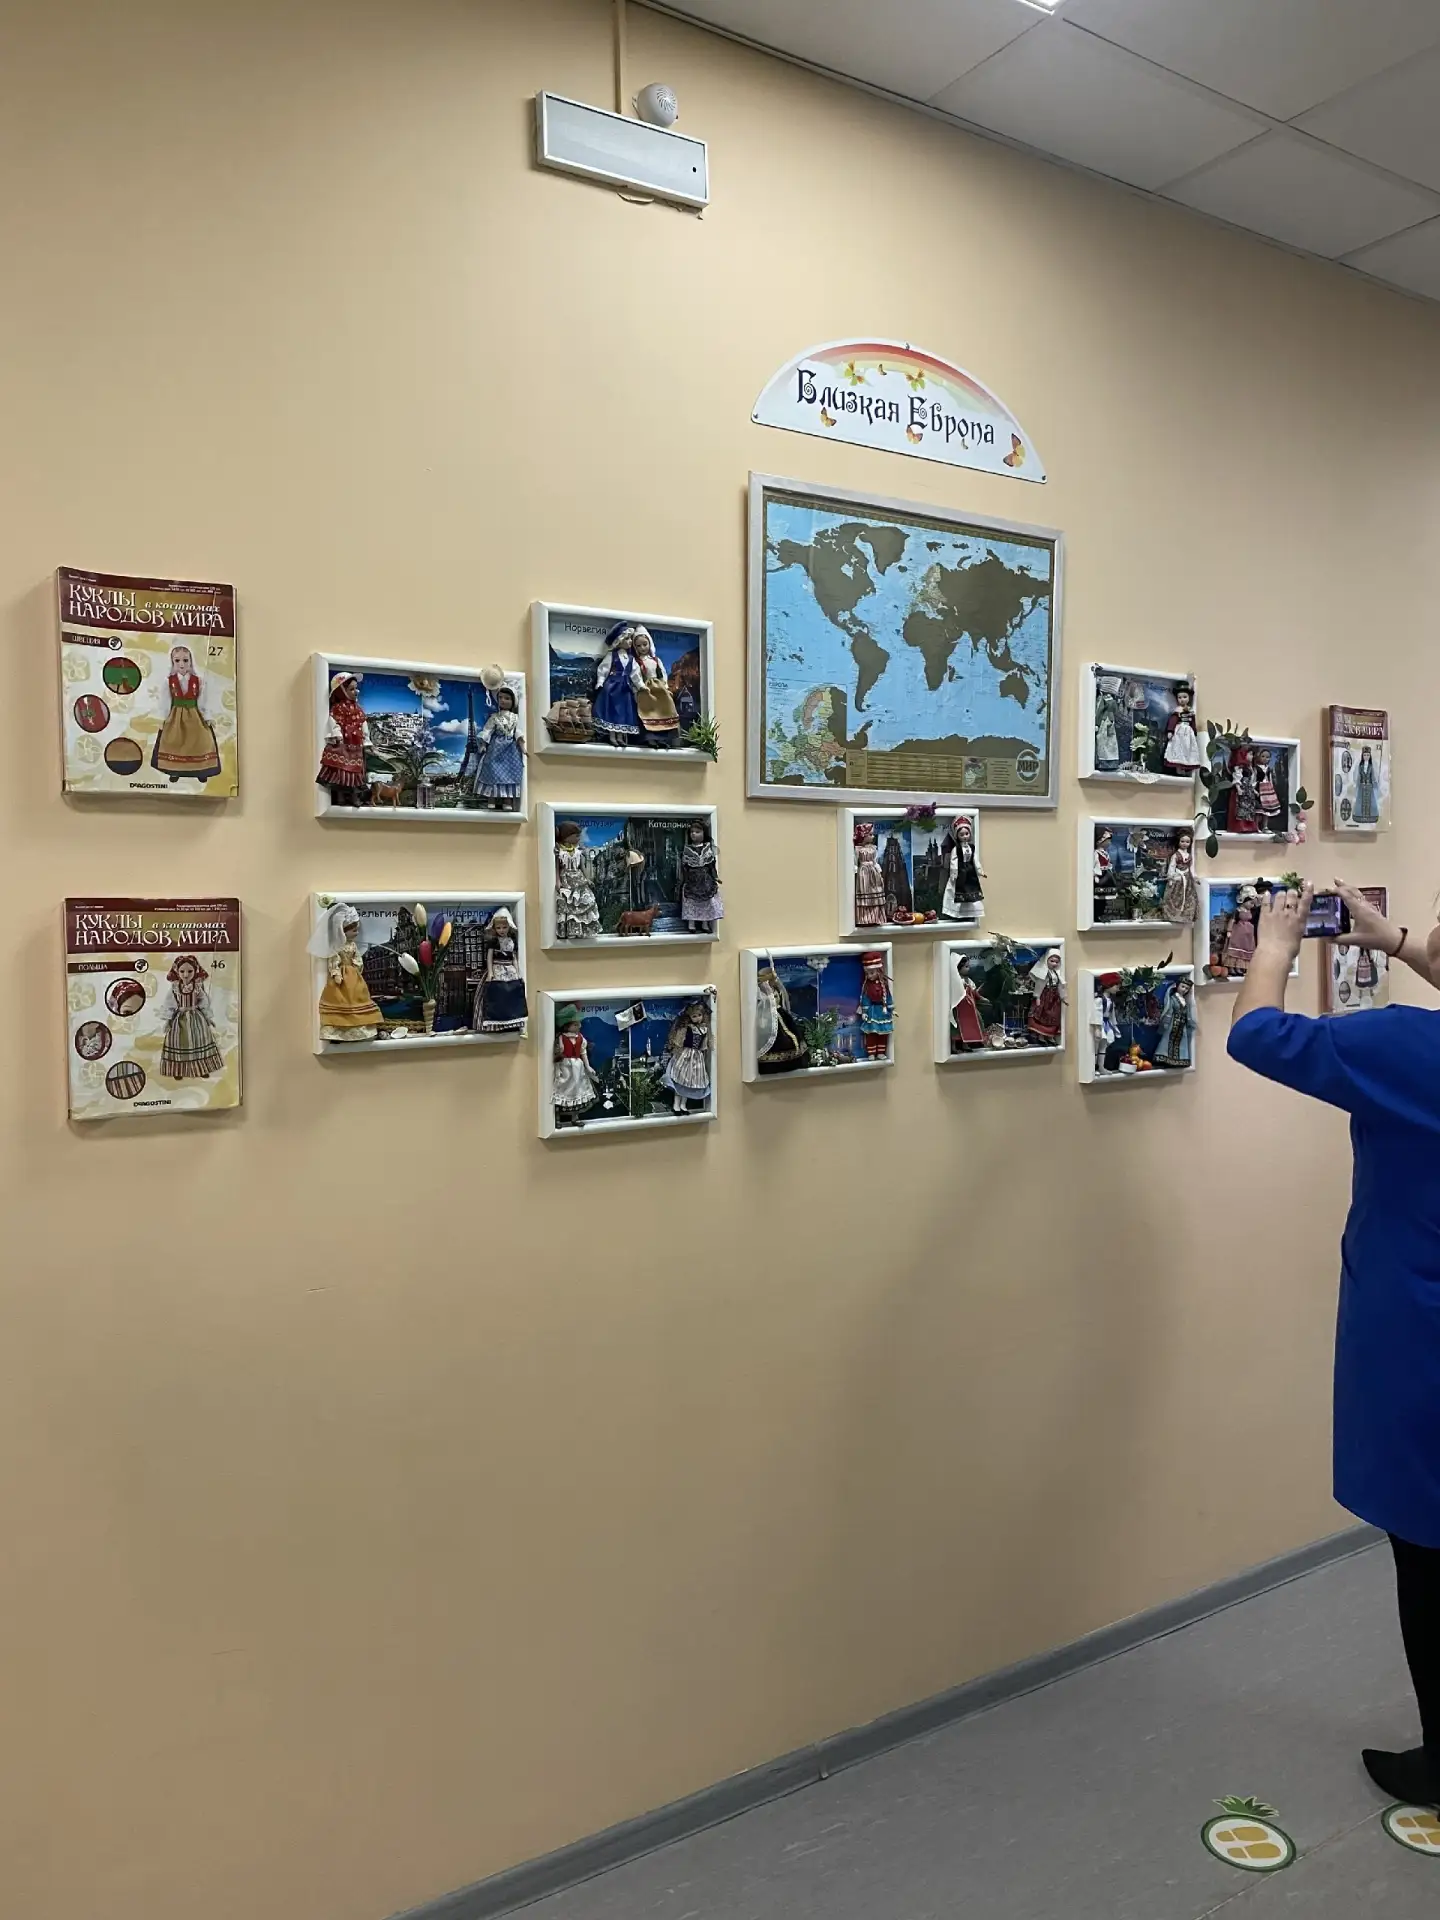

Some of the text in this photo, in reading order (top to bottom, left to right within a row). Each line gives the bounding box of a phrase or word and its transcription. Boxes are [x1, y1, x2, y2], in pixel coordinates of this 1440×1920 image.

[796, 368, 995, 446] Близкая Европа
[69, 583, 136, 607] КУКЛЫ
[155, 601, 221, 613] костюмах
[68, 600, 226, 629] НАРОДОВ МИРА
[208, 645, 223, 656] 27
[75, 914, 143, 930] КУКЛЫ
[162, 921, 227, 930] костюмах
[74, 929, 231, 948] НАРОДОВ МИРА
[210, 959, 226, 969] 46
